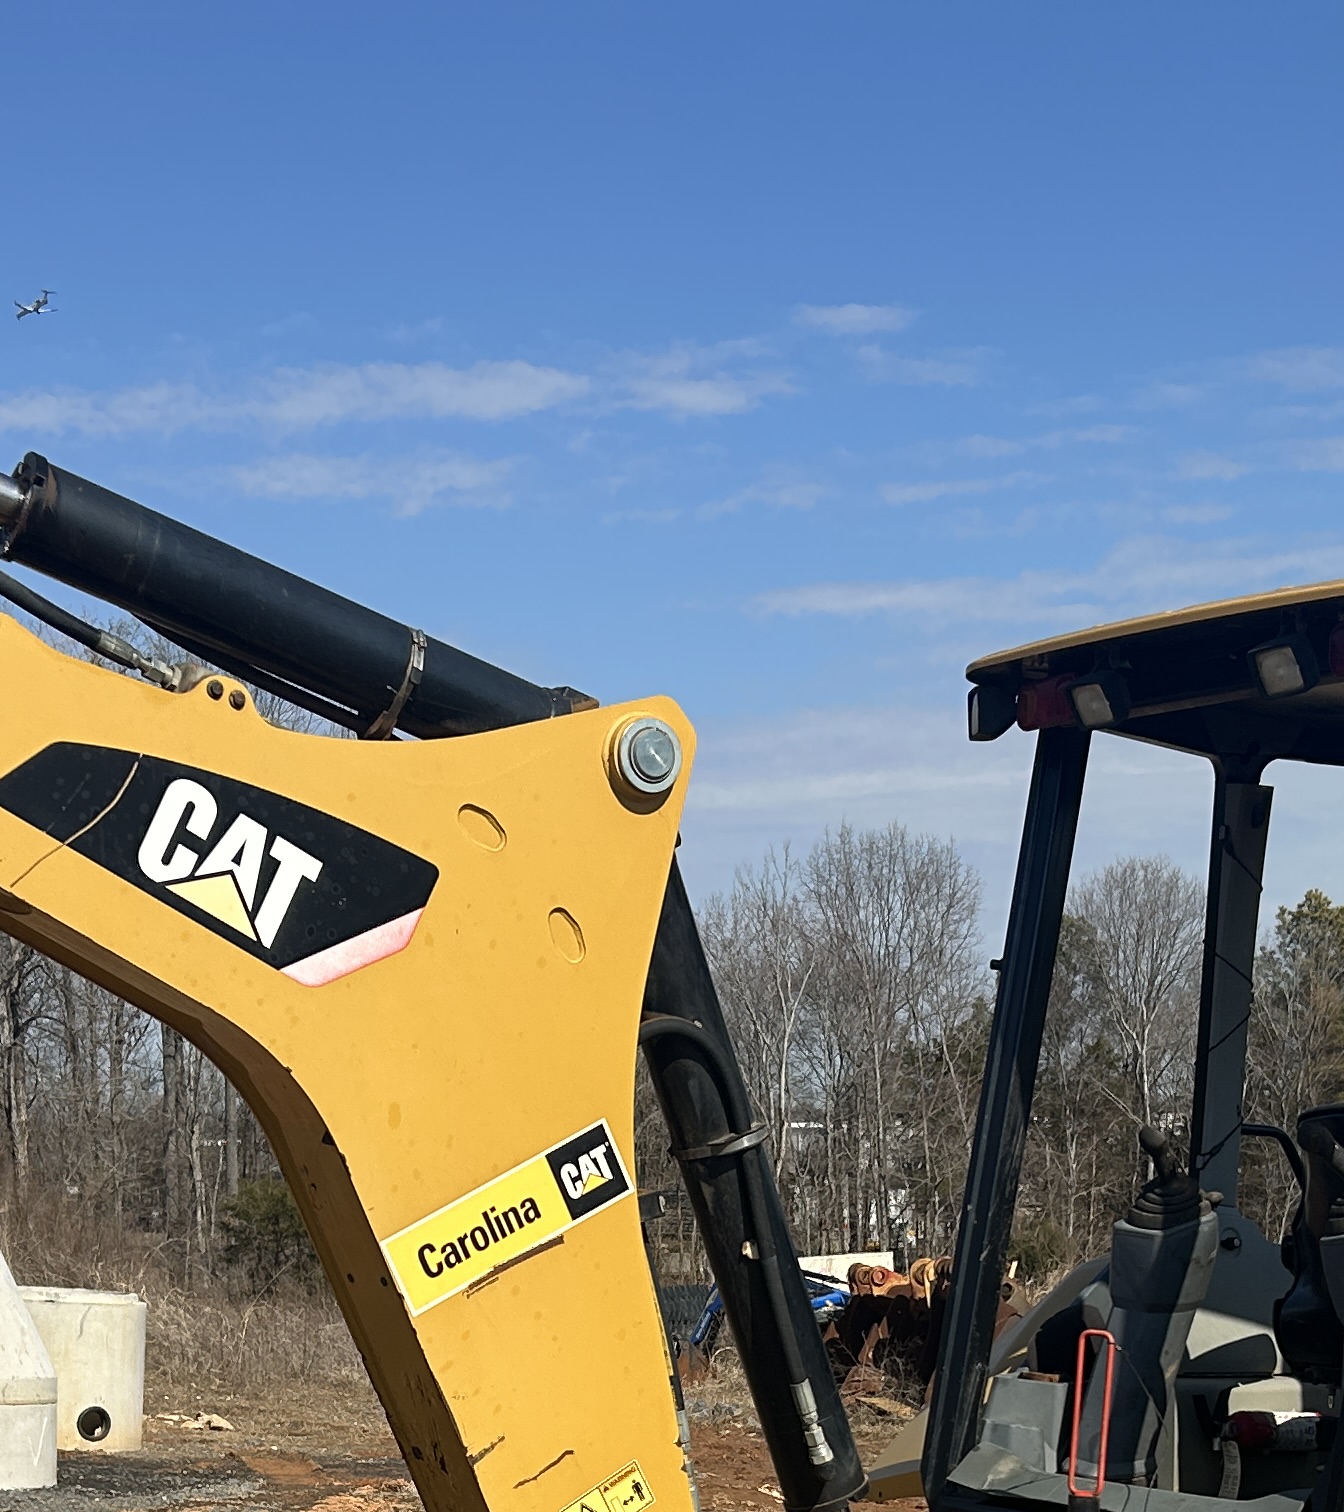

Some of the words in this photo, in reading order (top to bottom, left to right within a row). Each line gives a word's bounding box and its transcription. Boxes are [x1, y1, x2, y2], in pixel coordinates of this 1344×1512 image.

[139, 778, 323, 949] CAT
[417, 1197, 542, 1278] Carolina
[560, 1142, 614, 1200] CAT
